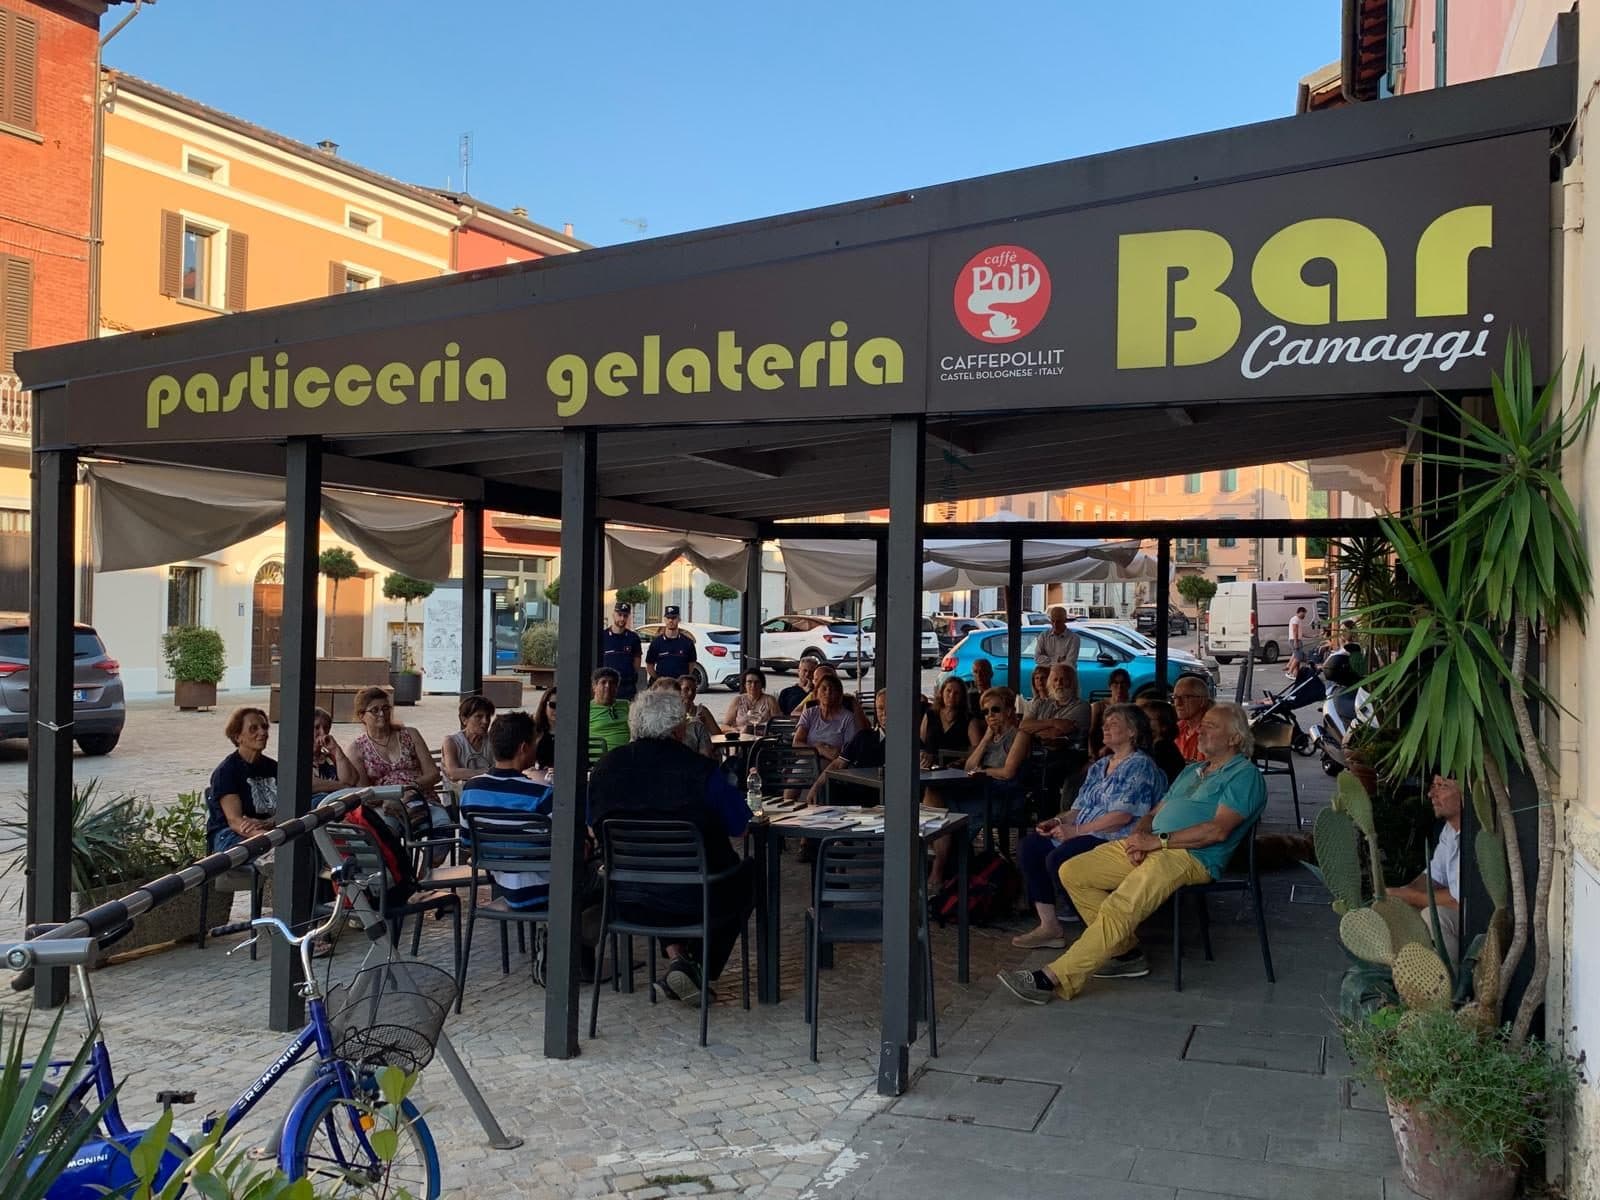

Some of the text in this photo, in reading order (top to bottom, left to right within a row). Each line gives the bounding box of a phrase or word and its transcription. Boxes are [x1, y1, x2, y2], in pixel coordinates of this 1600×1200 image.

[984, 251, 1017, 267] caffè
[971, 263, 1040, 293] Poli
[1117, 205, 1494, 370] Bar
[940, 349, 1065, 371] CAFFEPOLI.IT
[1240, 313, 1495, 379] Camaggi
[146, 321, 904, 428] pasticceria gelateria
[940, 371, 975, 381] CASTEL
[976, 368, 1033, 380] BOLOGNESE
[1038, 366, 1065, 376] ITALY
